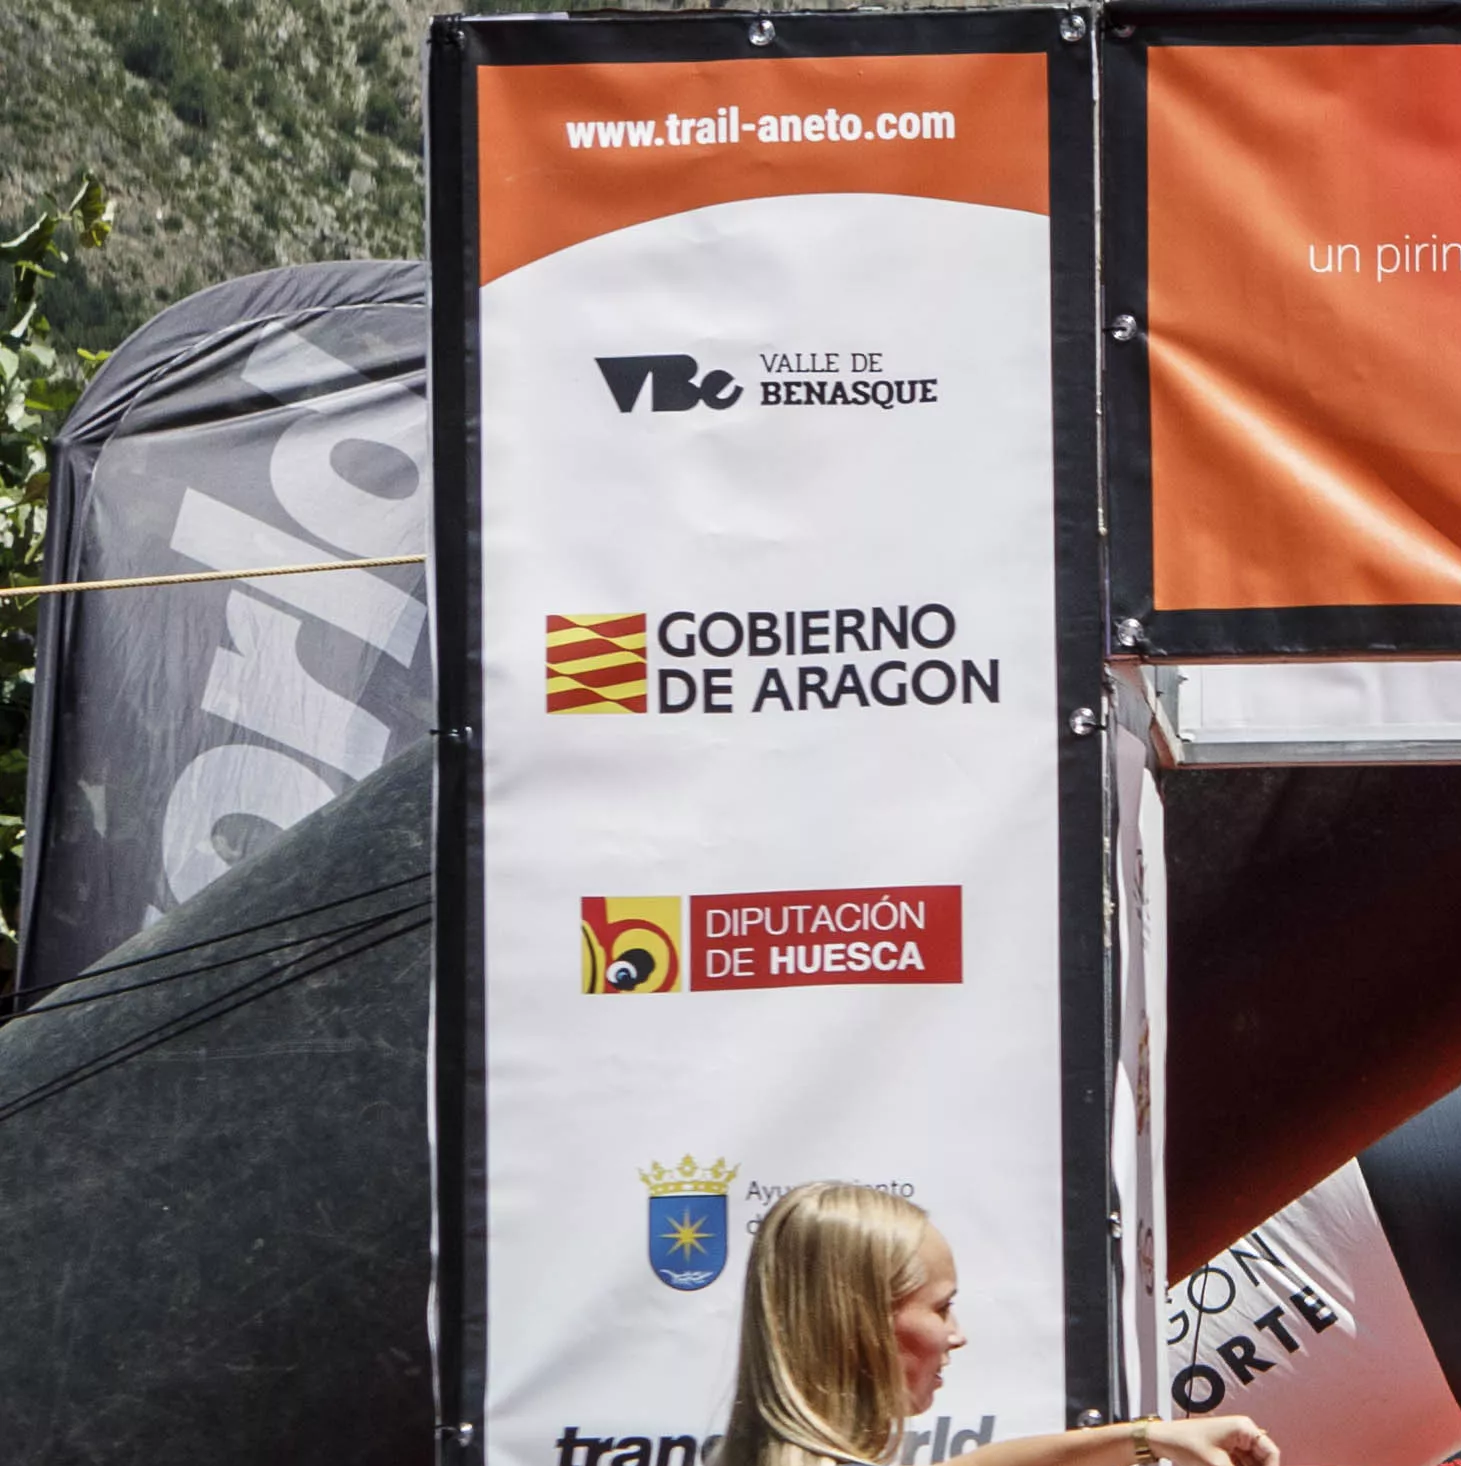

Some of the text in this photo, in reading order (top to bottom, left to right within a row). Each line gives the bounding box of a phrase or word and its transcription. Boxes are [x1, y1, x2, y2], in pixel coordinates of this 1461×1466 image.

[565, 107, 957, 149] www.trail-aneto.com
[1309, 237, 1363, 273] un
[760, 353, 885, 374] VALLE DE
[760, 377, 938, 411] BENASQUE
[658, 603, 957, 658] GOBIERNO
[659, 658, 1001, 715] DE ARAGON
[705, 896, 926, 938] DIPUTACIÓN
[706, 941, 925, 978] DE HUESCA
